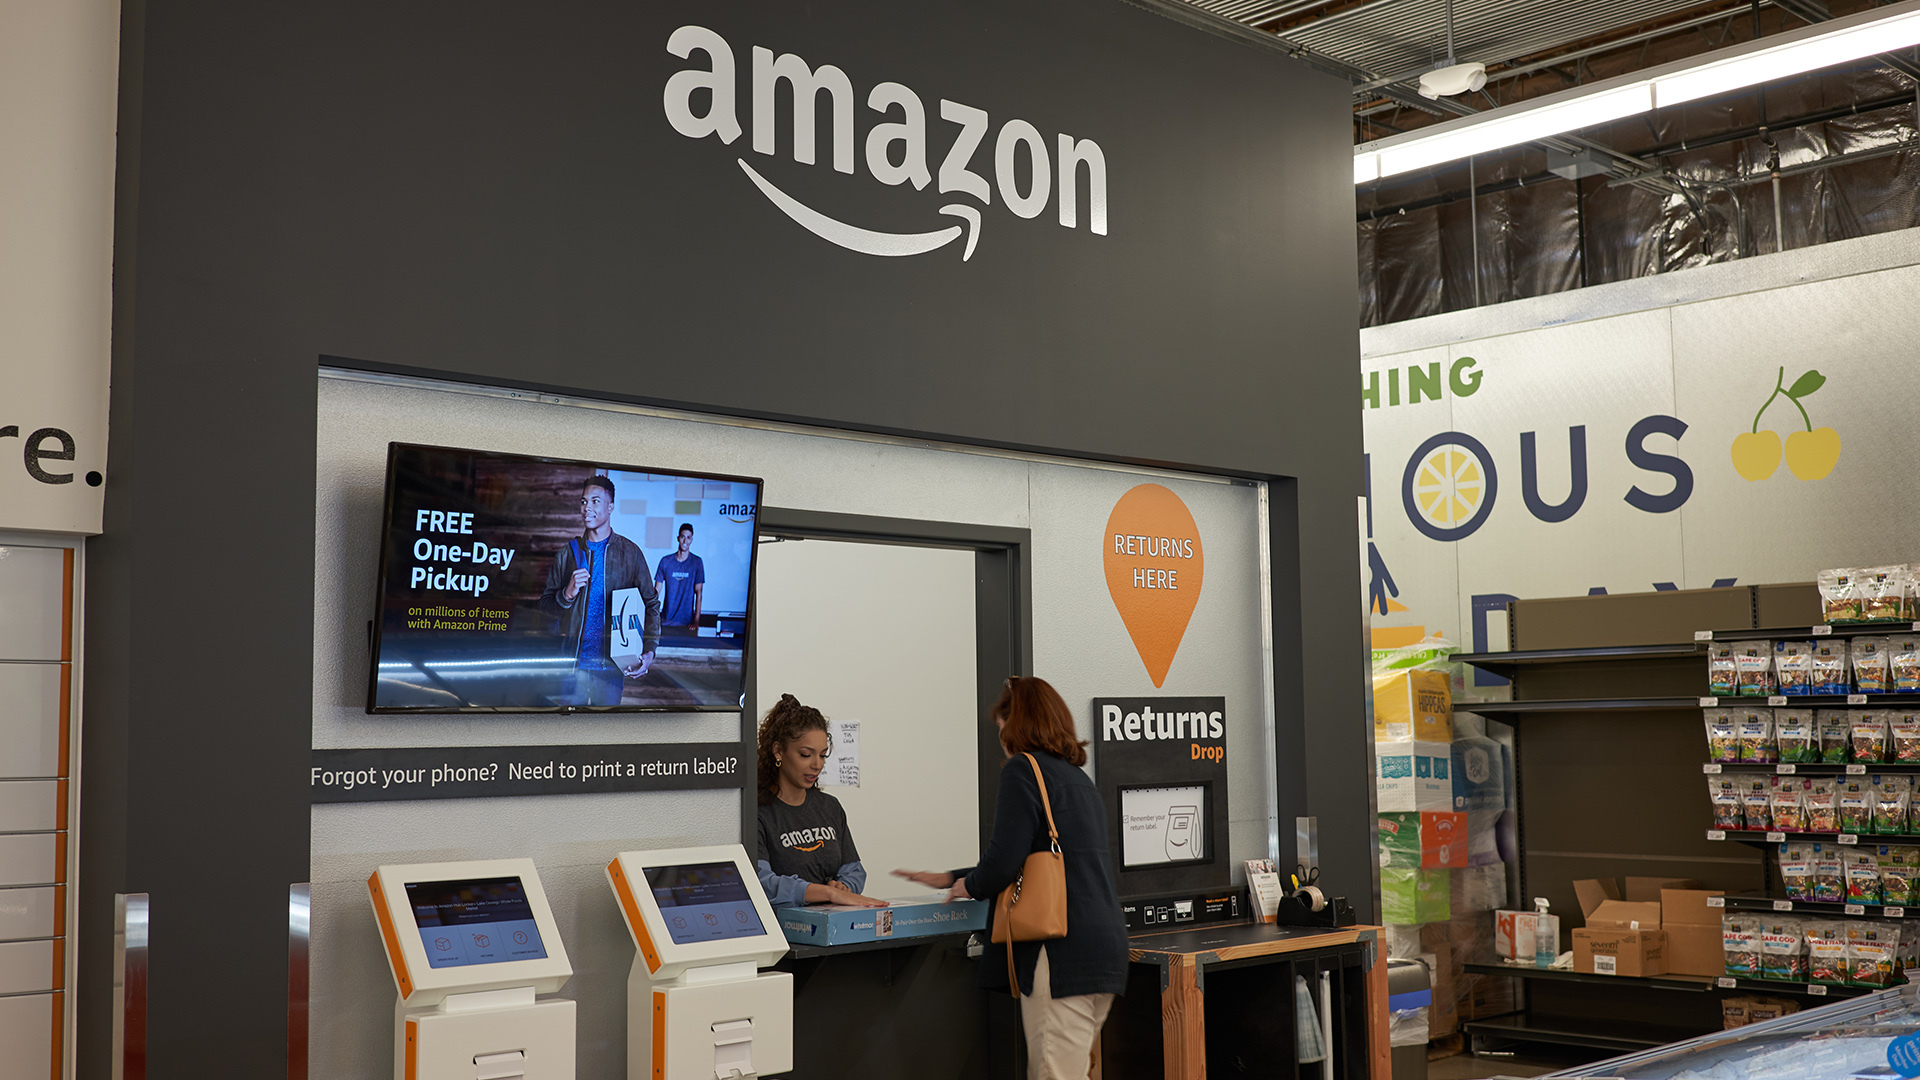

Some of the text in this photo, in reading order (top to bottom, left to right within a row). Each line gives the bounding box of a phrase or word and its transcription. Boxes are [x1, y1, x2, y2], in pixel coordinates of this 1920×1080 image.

[663, 25, 1108, 237] amazon
[415, 509, 475, 535] FREE
[413, 537, 516, 571] One-Day
[1114, 533, 1194, 560] RETURNS
[410, 566, 490, 597] Pickup
[1132, 568, 1178, 590] HERE
[408, 606, 510, 619] on millions of items
[407, 618, 507, 631] with Amazon Prime
[1418, 694, 1446, 714] HIPPEAS
[1102, 703, 1224, 741] Returns
[1191, 743, 1224, 763] Drop
[311, 757, 738, 790] Forgot your phone? Need to print a return label?
[780, 825, 837, 848] amazon
[932, 912, 950, 923] Shoe
[950, 909, 968, 921] Rack
[1590, 940, 1620, 949] seventh
